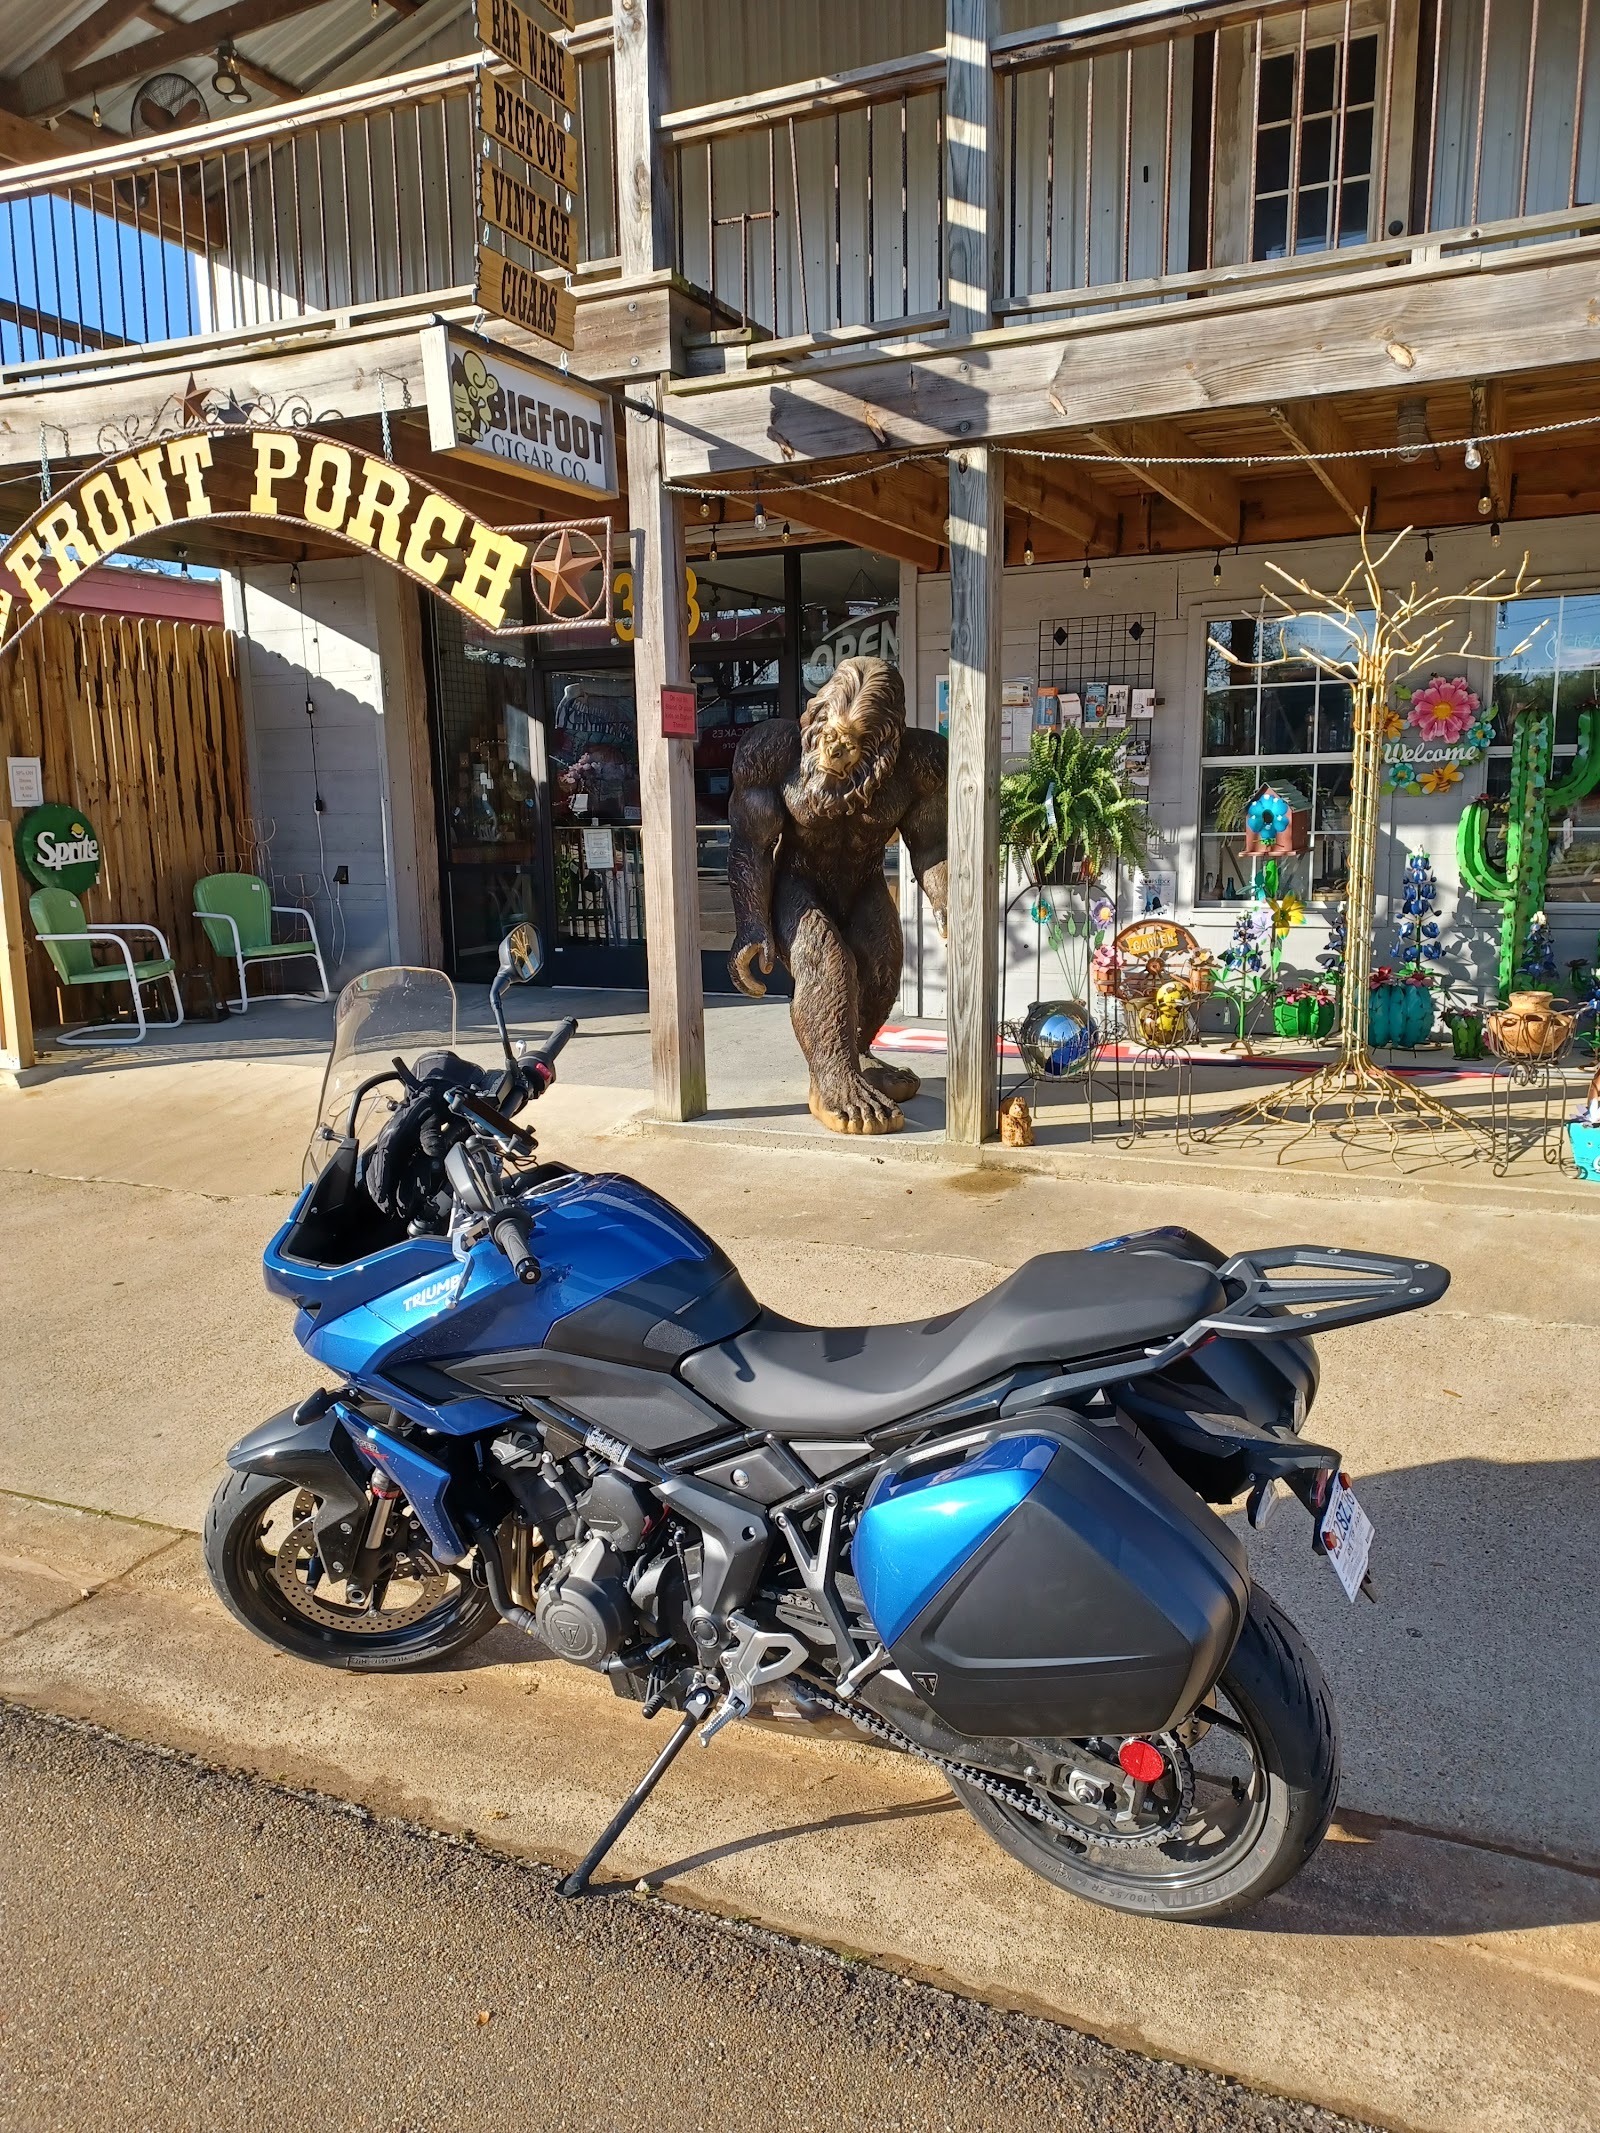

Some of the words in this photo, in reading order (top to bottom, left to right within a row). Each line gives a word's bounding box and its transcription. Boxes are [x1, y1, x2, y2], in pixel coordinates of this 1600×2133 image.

[492, 0, 521, 67] BAR
[527, 18, 565, 102] WARE
[493, 80, 566, 181] BIGFOOT
[491, 166, 570, 264] VINTAGE
[501, 261, 558, 337] CIGARS
[487, 385, 603, 465] BIGFOOT
[491, 433, 553, 473] CIGAR
[560, 457, 590, 484] CO.
[4, 433, 213, 616] FRONT
[249, 432, 528, 629] PORCH
[803, 615, 900, 695] OPEN
[1382, 742, 1479, 763] Welcome
[37, 827, 99, 870] Sprite
[1132, 933, 1175, 951] GARDEN
[402, 1271, 470, 1312] TRIUMP
